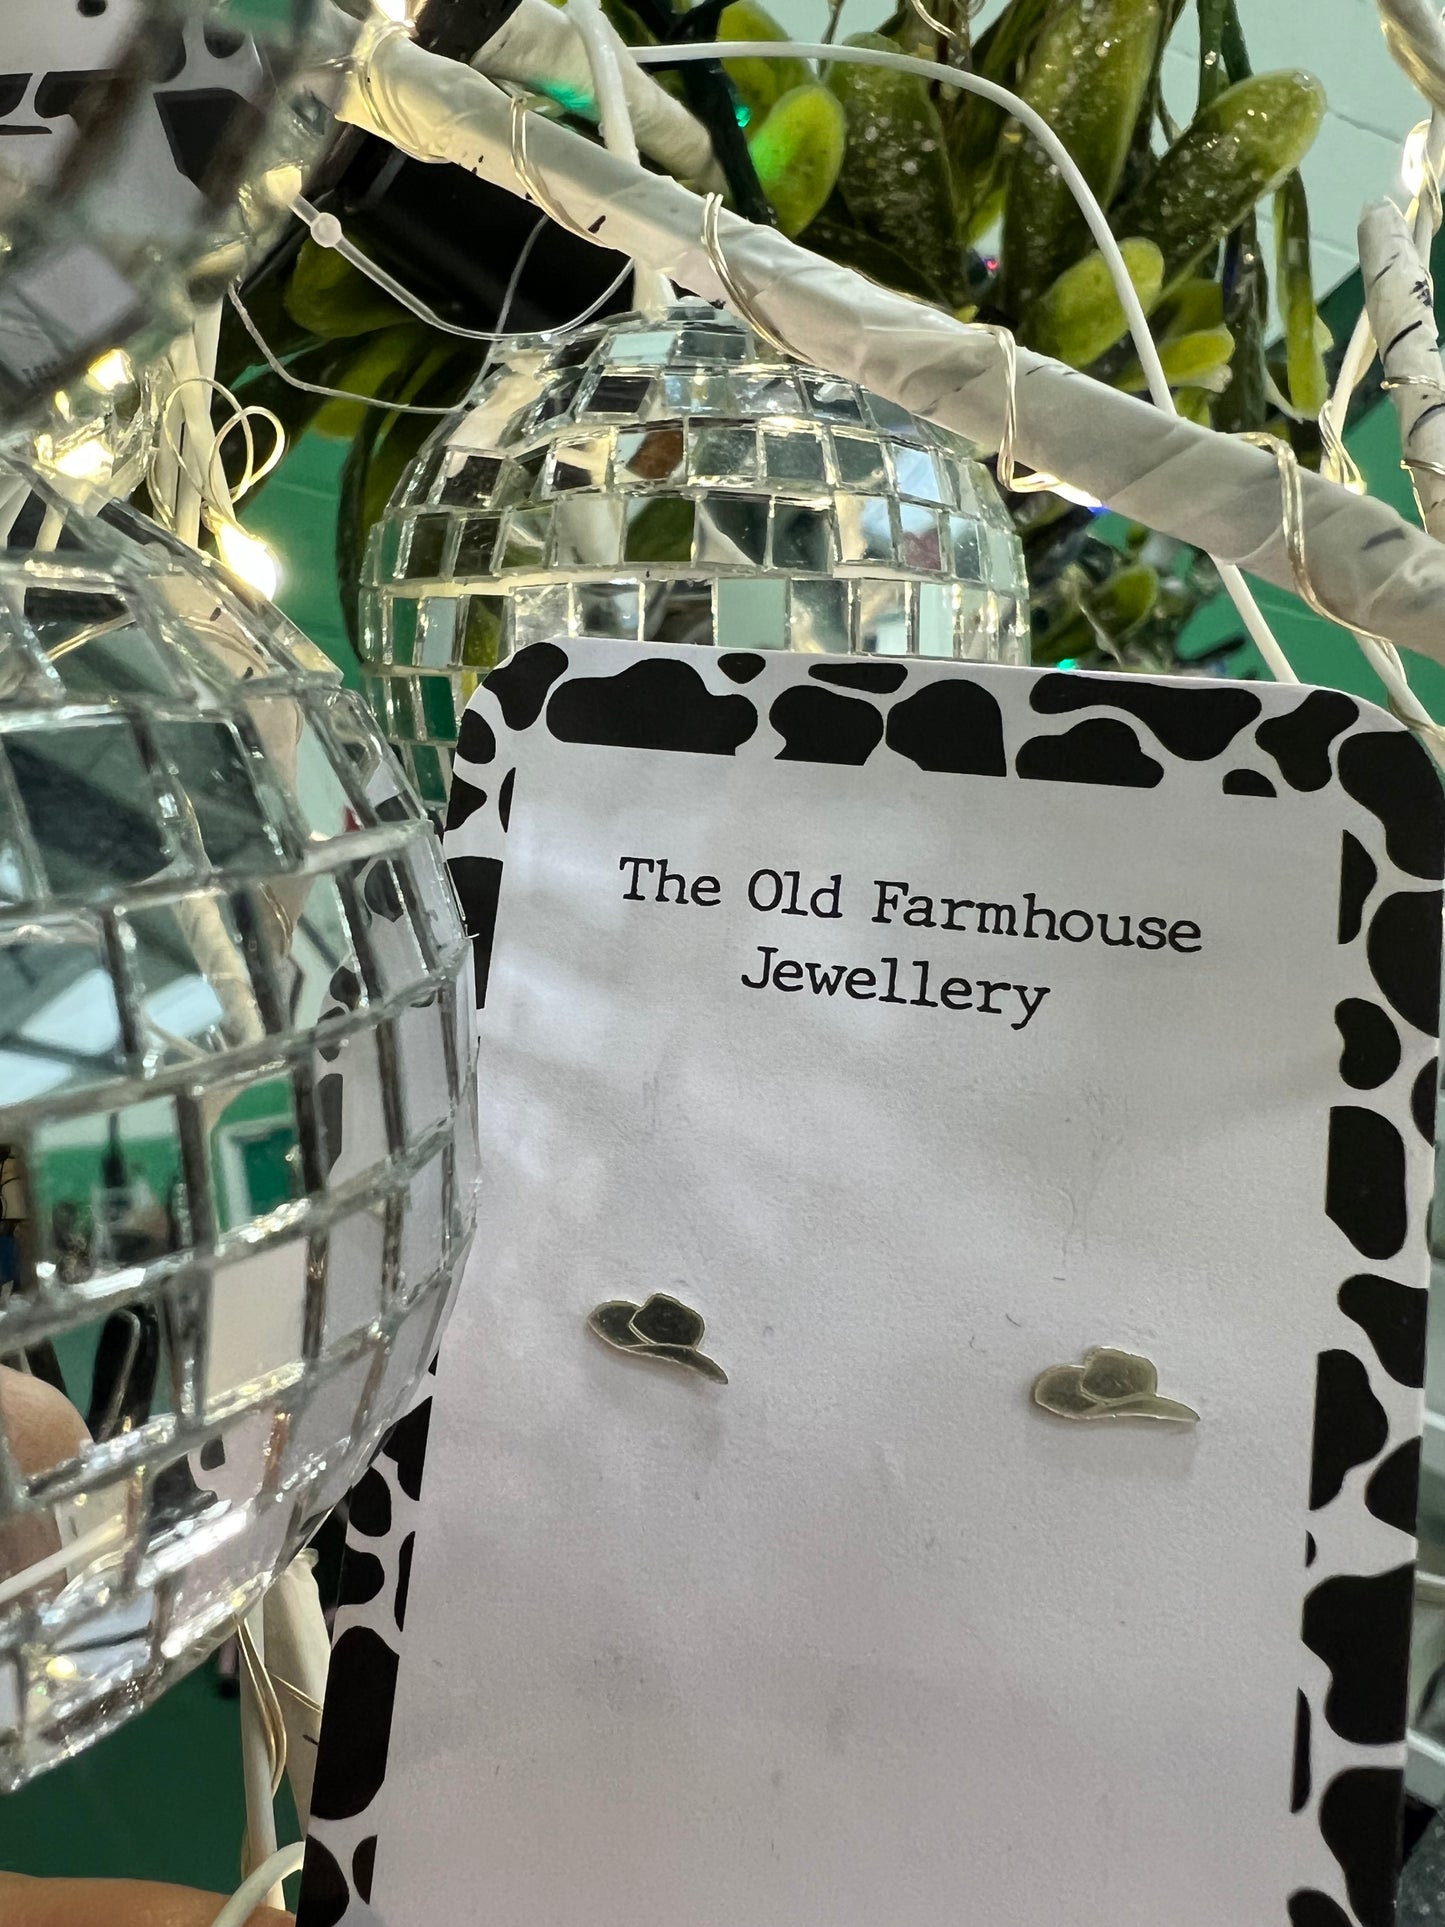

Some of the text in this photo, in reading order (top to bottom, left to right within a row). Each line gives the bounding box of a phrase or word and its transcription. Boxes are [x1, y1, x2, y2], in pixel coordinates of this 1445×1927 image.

[619, 856, 1203, 953] The Old Farmhouse
[741, 946, 1052, 1030] Jewellery
